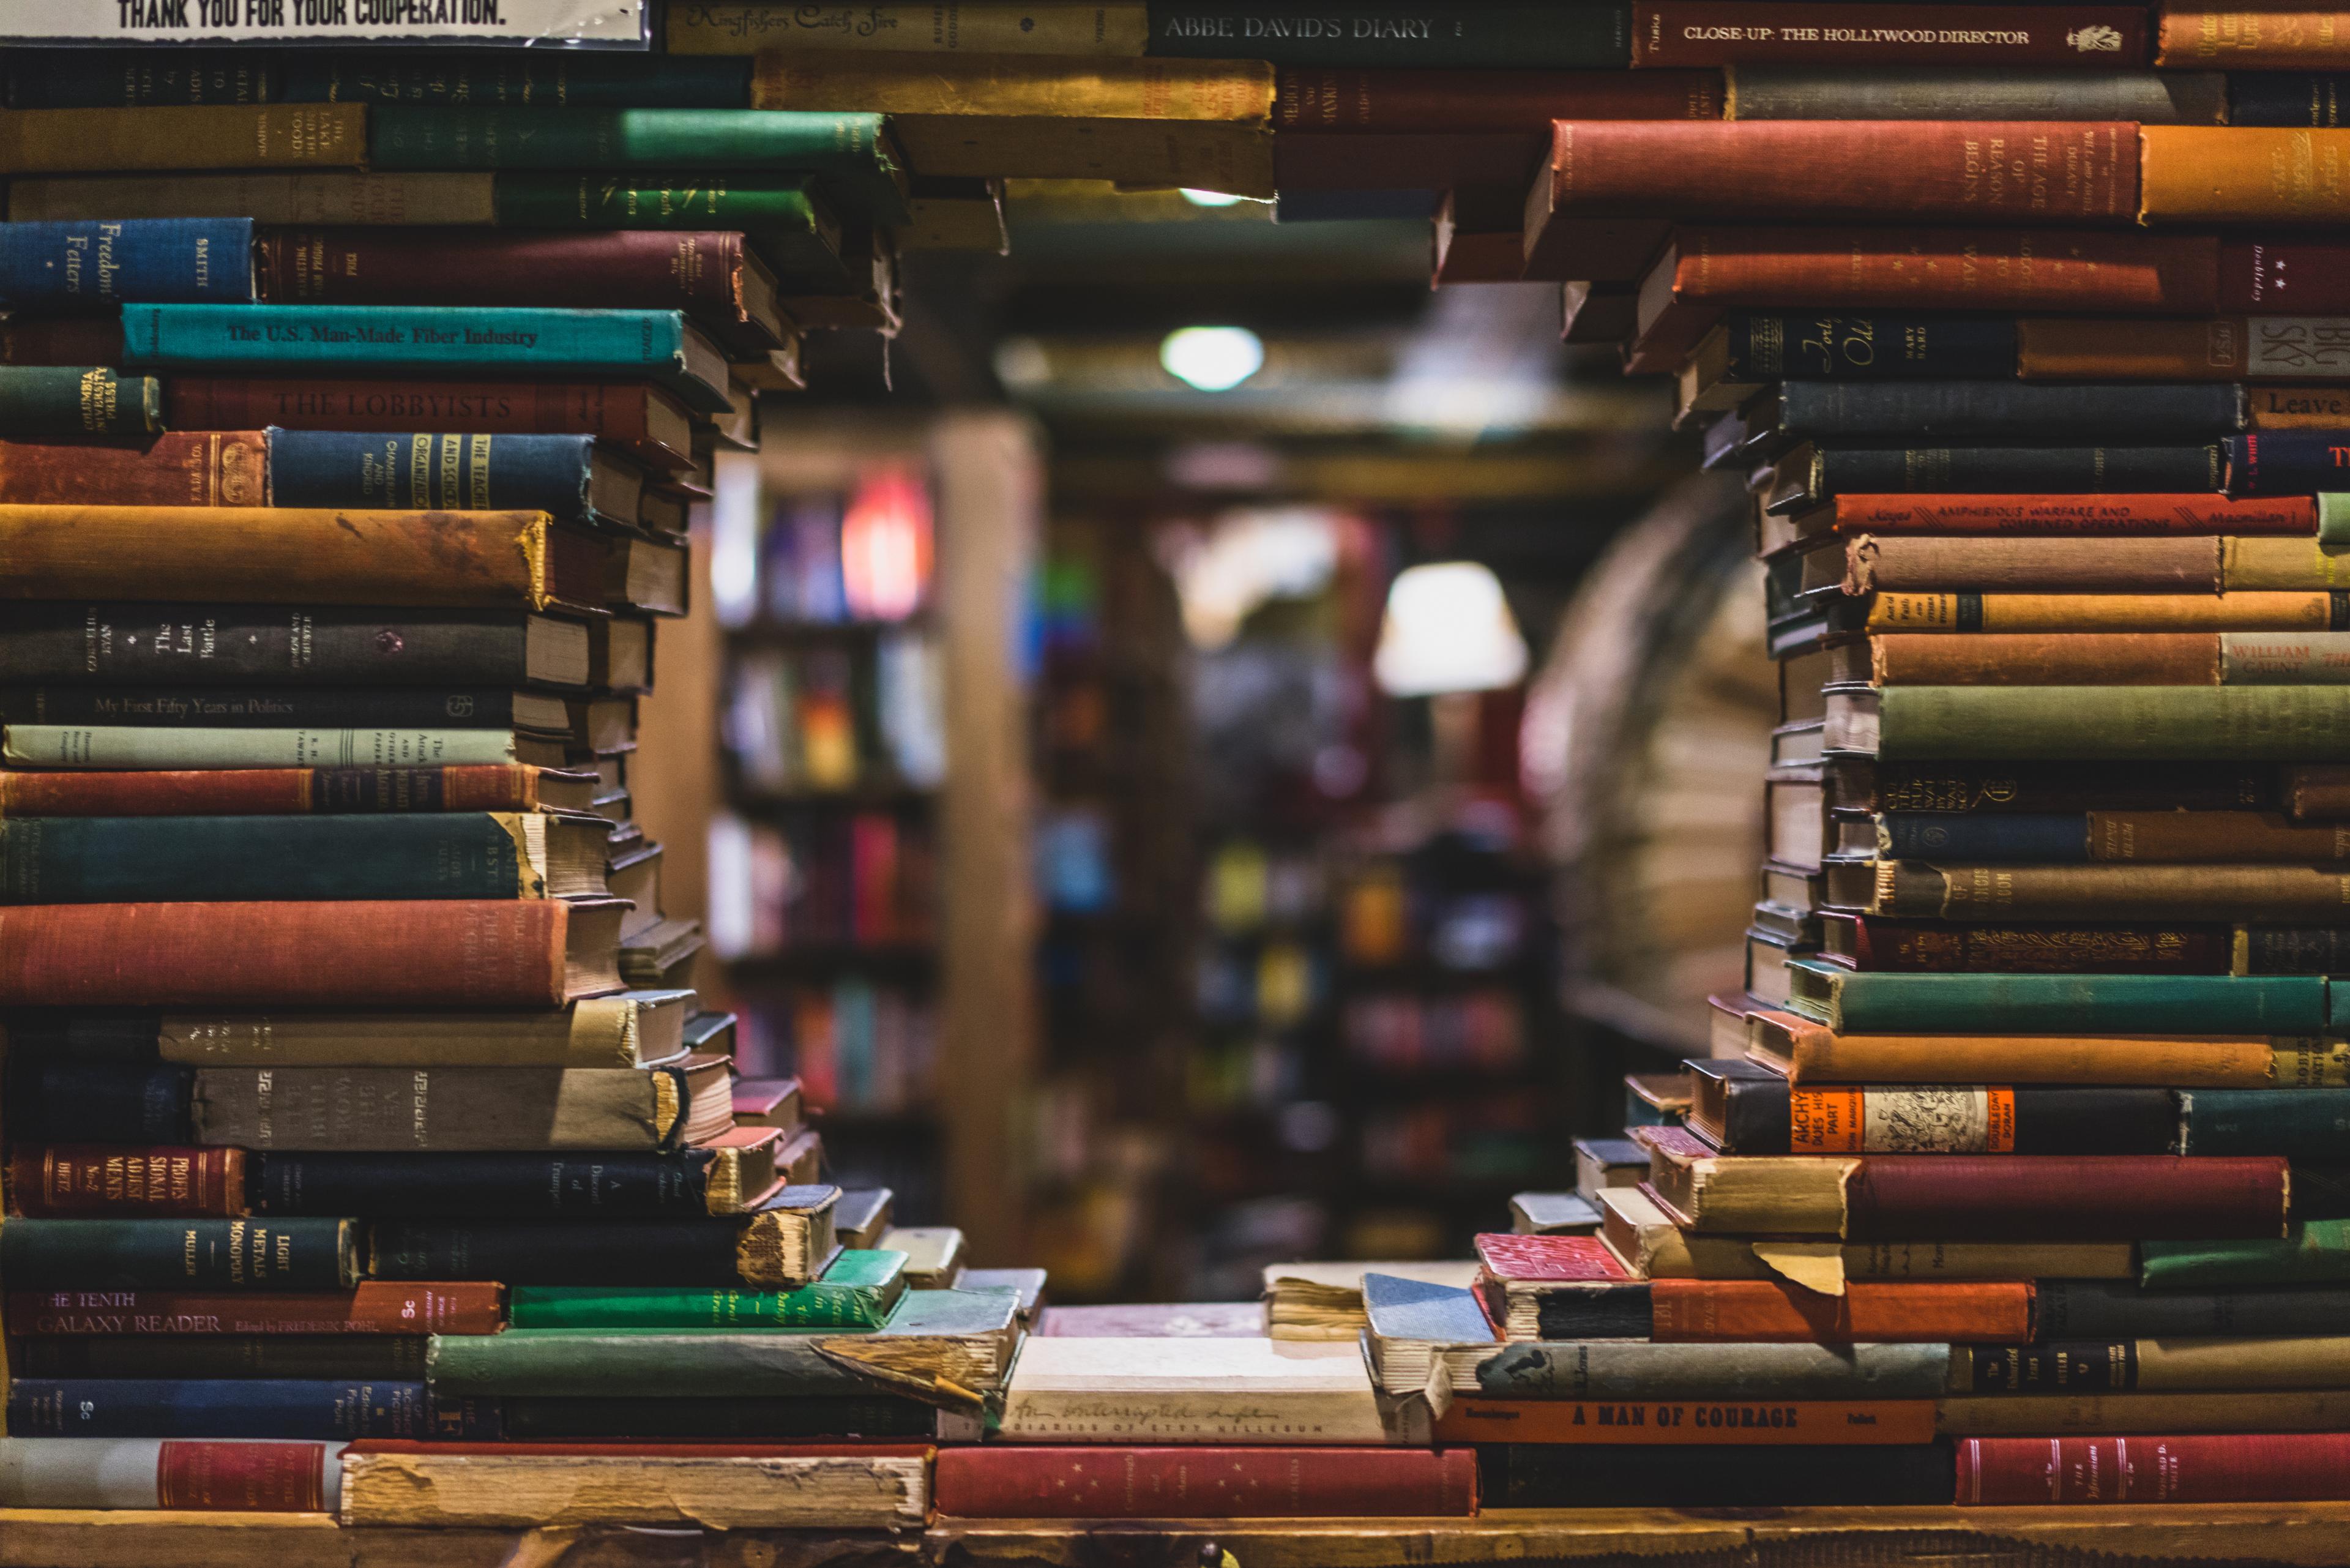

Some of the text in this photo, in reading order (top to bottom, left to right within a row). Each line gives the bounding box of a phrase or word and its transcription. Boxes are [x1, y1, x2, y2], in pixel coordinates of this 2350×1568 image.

[118, 0, 507, 28] THANK YOU FOR YOUR COOPERATION.
[687, 6, 898, 37] Kingfishers Catch Fire
[1165, 17, 1434, 39] ABBE DAVID'S DIARY
[1683, 26, 2029, 44] CLOSE-UP: THE HOLLYWOOD DIRECTOR
[1965, 140, 1980, 202] BEGINS
[1990, 137, 2005, 204] REASON
[2012, 159, 2027, 182] OF
[2031, 136, 2048, 208] THE AGE
[66, 235, 89, 294] Fetters
[196, 237, 210, 288] SMITH
[2251, 245, 2264, 302] Doubleday
[229, 324, 538, 348] The U.S. Man-Made Fiber Industry
[1843, 318, 1874, 365] Odd
[1904, 326, 1915, 360] MARY
[1915, 326, 1926, 360] BARD
[2261, 325, 2307, 367] SKY
[81, 370, 95, 431] COLUMBIA
[105, 381, 117, 420] PRESS
[275, 392, 511, 420] THE LOBBYISTS
[2269, 393, 2343, 414] Leave
[446, 439, 458, 464] AND
[476, 440, 488, 460] THE
[362, 452, 373, 495] KINDRED
[373, 463, 384, 485] AND
[1938, 506, 2131, 518] AMPHIBIOUS WARFARE AND
[1999, 518, 2170, 530] COMBINED OPERATIONS
[86, 606, 97, 673] CORNELIUS
[99, 624, 112, 655] RYAN
[154, 624, 171, 655] The
[176, 624, 193, 655] Last
[199, 618, 215, 660] Battle
[289, 613, 300, 635] AND
[302, 616, 312, 665] SCHUSTER
[2232, 646, 2310, 658] WILLIAM
[95, 696, 294, 717] My First Fifty Years in Politics
[388, 732, 397, 764] OTHER
[417, 733, 428, 764] Attack
[433, 737, 443, 759] The
[1794, 1093, 1810, 1144] ARCHY
[1811, 1092, 1825, 1146] DOES HIS
[1826, 1103, 1839, 1135] PART
[1989, 1092, 2002, 1150] DOUBLEDAY
[2002, 1103, 2012, 1139] DORAN
[1847, 1132, 1857, 1151] DON
[57, 1162, 72, 1192] DIETZ
[106, 1156, 124, 1200] MENTS
[127, 1157, 144, 1200] ADJUST
[148, 1156, 168, 1202] SIONAL
[171, 1156, 190, 1200] PROFES
[572, 1179, 583, 1190] of
[590, 1165, 603, 1204] Discord
[610, 1179, 621, 1190] A
[185, 1230, 198, 1276] MULLER
[229, 1220, 246, 1283] MONOPOLY
[253, 1227, 267, 1278] METALS
[276, 1234, 291, 1271] LIGHT
[37, 1292, 136, 1309] THE TENTH
[401, 1300, 416, 1320] Sc
[728, 1289, 739, 1322] Carol
[773, 1290, 790, 1324] Daisy
[813, 1296, 827, 1309] in
[37, 1315, 222, 1333] GALAXY READER
[278, 1321, 340, 1333] FREDERIK
[1987, 1361, 2000, 1379] The
[2056, 1352, 2067, 1385] BUTLER
[79, 1400, 94, 1421] Sc
[360, 1385, 373, 1421] Edited
[391, 1389, 402, 1434] FICTION
[463, 1400, 476, 1425] THE
[1573, 1406, 1797, 1428] A MAN OF COURAGE
[1013, 1423, 1098, 1433] DIARIES
[1114, 1423, 1135, 1433] OF
[1151, 1423, 1200, 1433] ETTY
[1177, 1465, 1188, 1500] Adams
[2088, 1444, 2100, 1501] Jeffersonians
